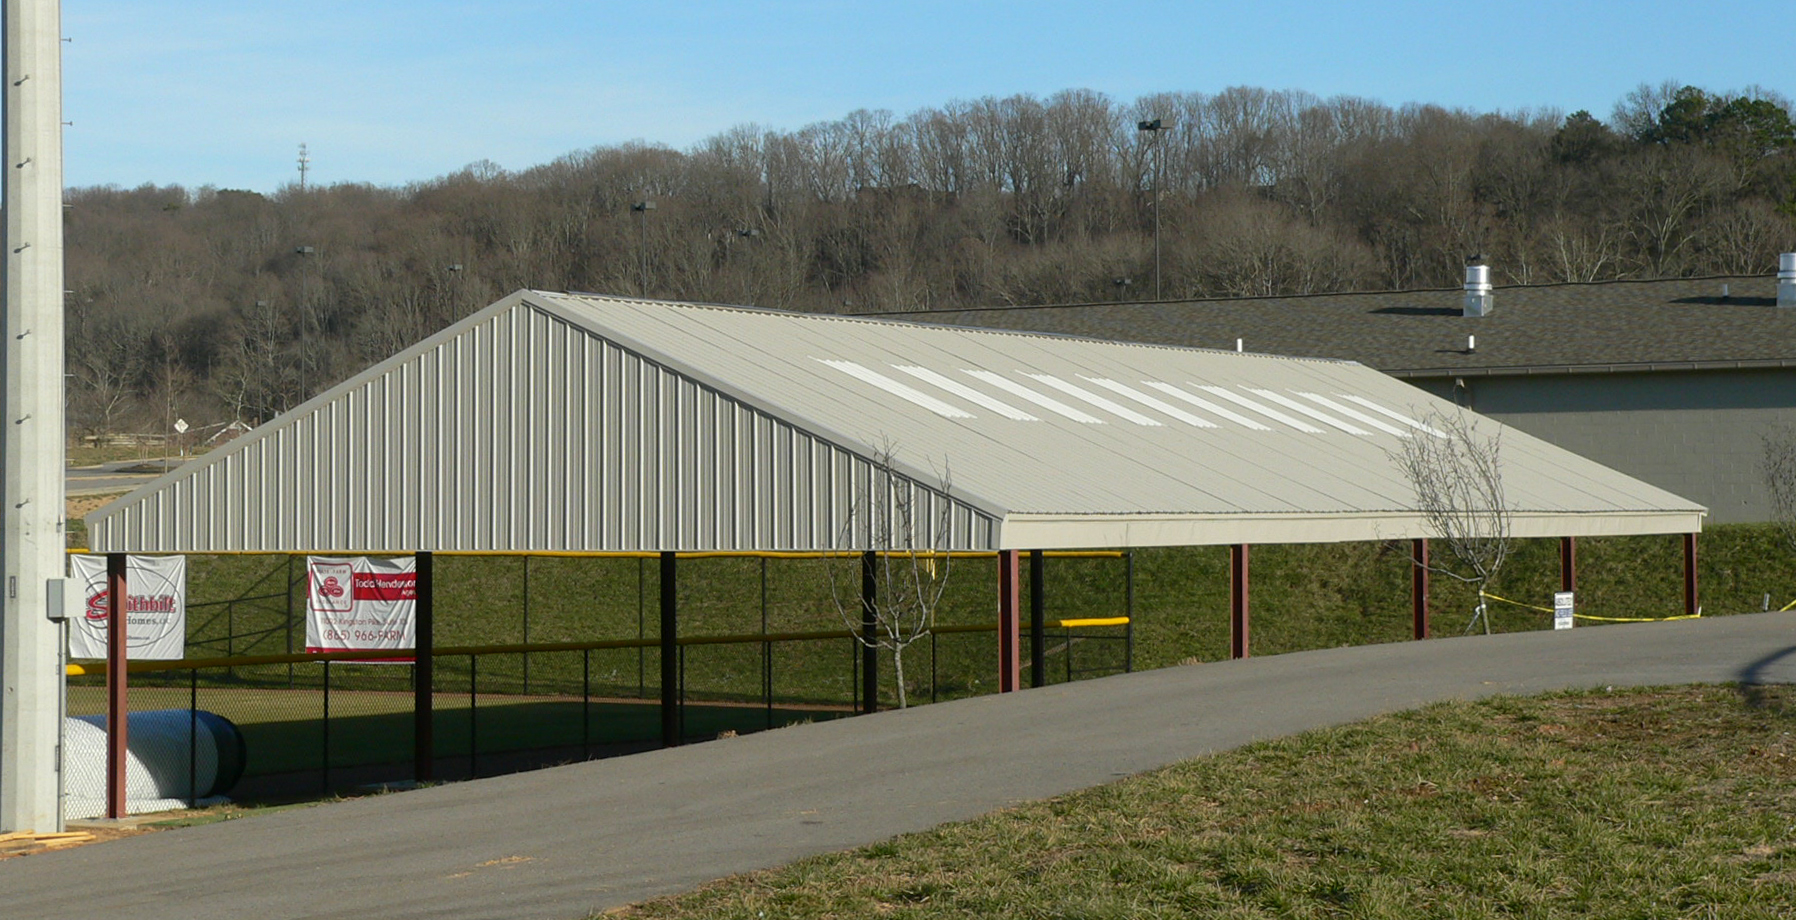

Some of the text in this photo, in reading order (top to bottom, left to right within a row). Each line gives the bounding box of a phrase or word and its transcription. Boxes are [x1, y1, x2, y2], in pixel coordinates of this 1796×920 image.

[86, 589, 176, 620] Sithbilt
[323, 629, 406, 641] (865) 966-FARM
